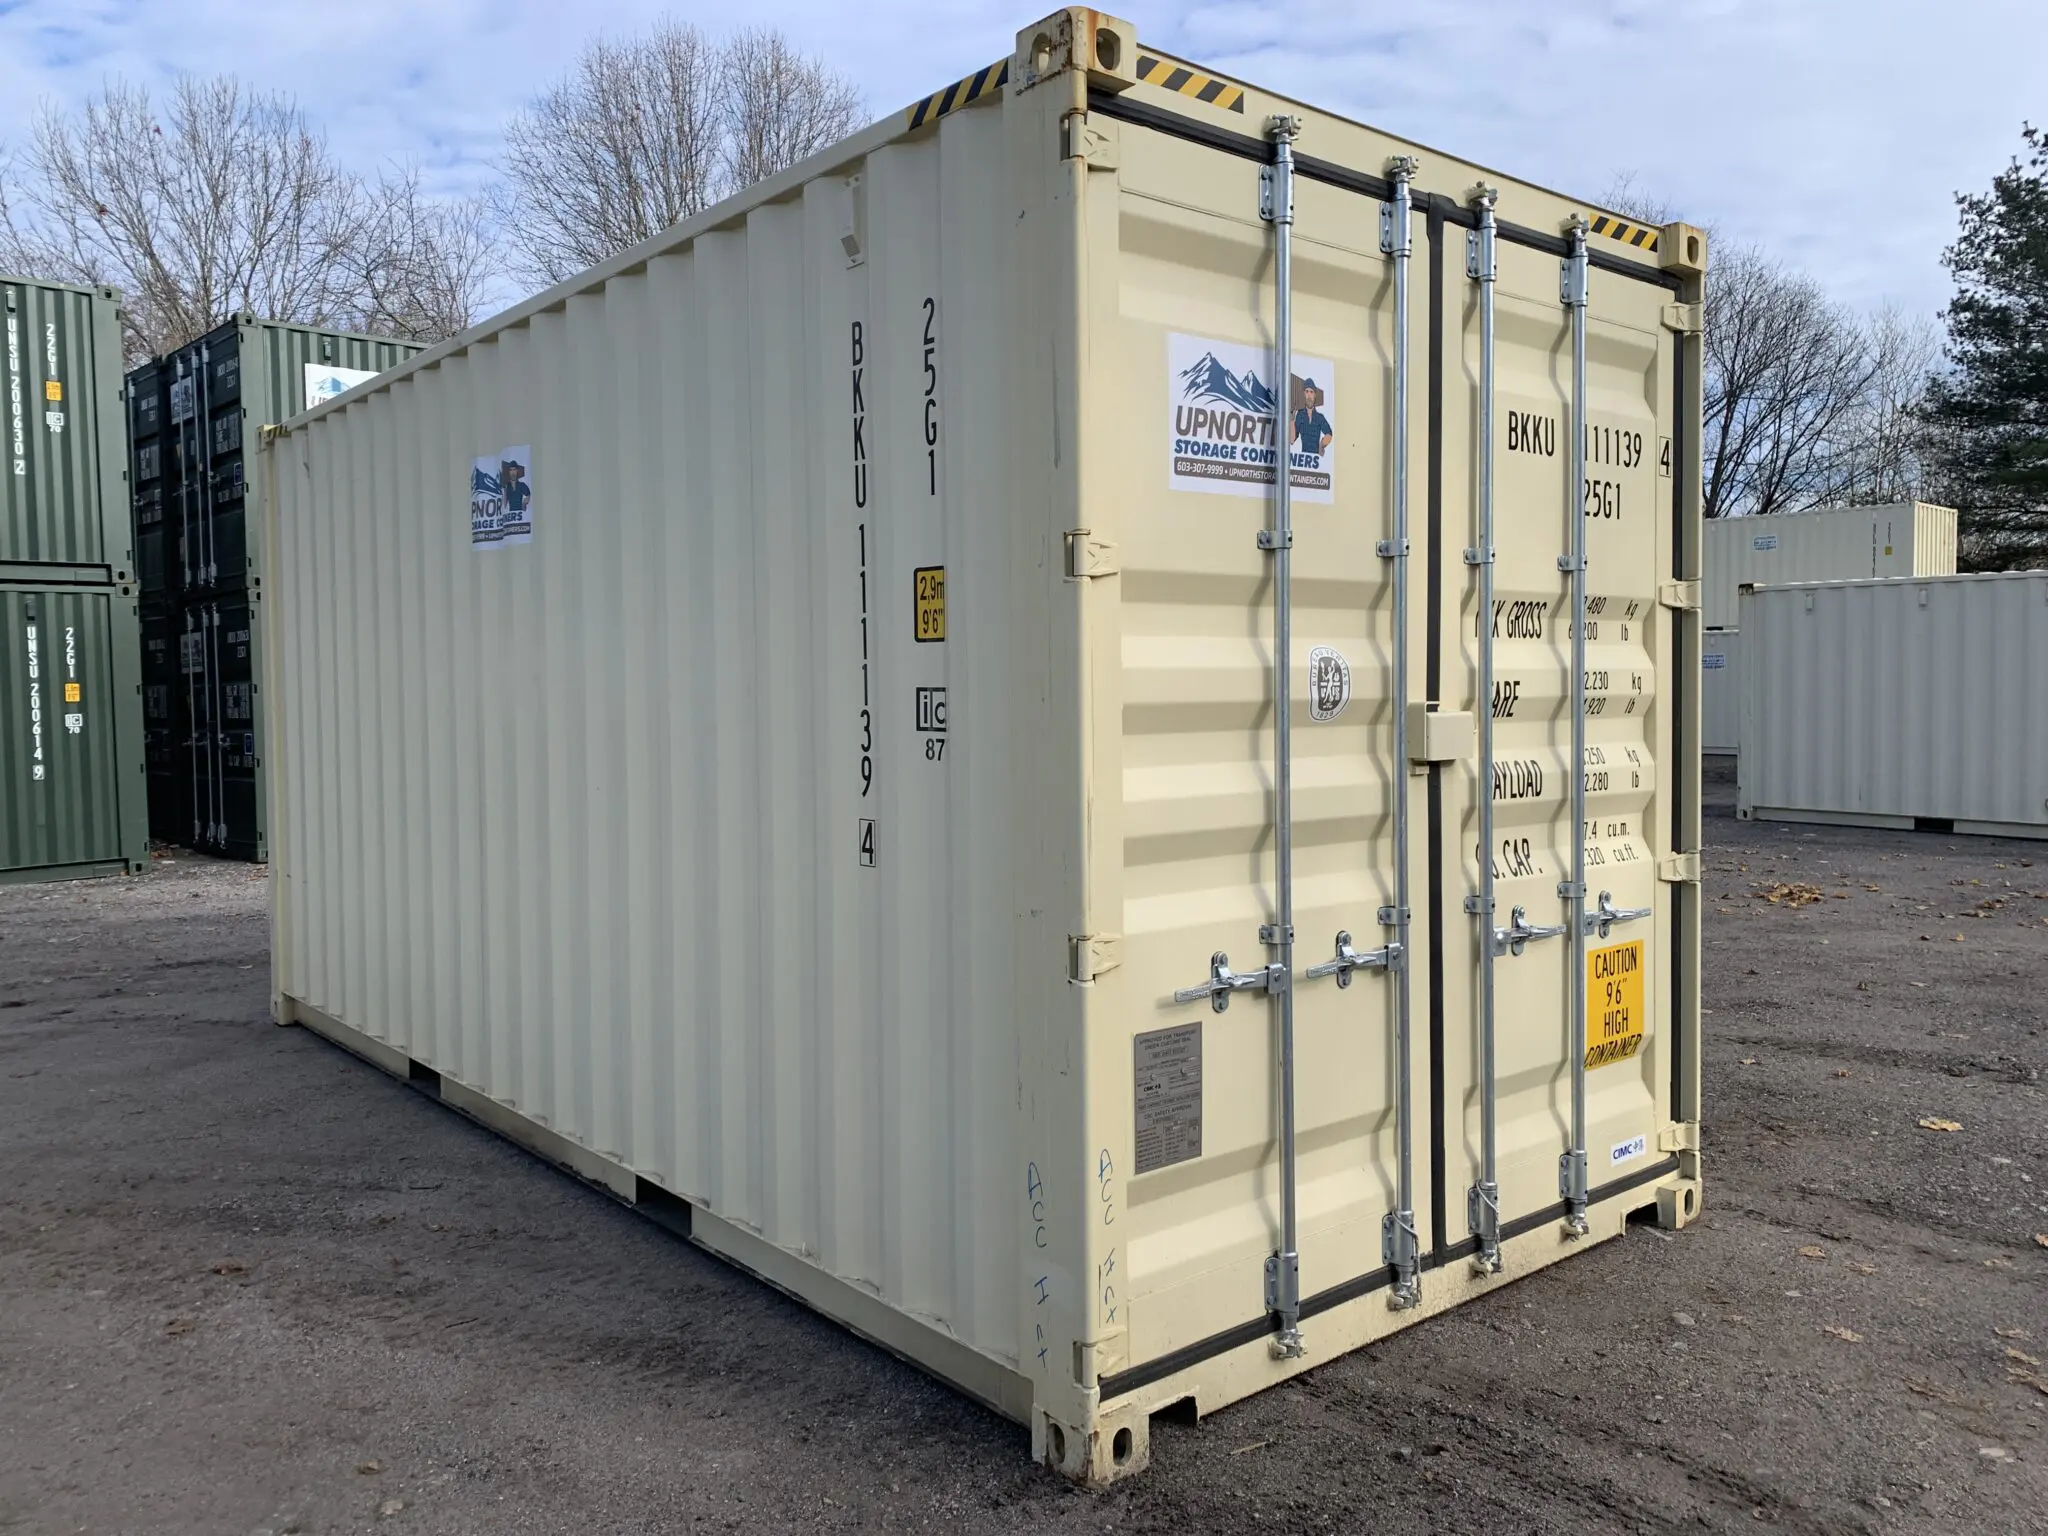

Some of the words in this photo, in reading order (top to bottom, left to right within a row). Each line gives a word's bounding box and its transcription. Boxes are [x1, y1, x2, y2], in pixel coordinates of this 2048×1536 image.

[7, 318, 19, 372] UNSU
[46, 323, 57, 376] 22G1
[851, 320, 867, 508] BKKU
[922, 297, 937, 496] 25G1
[11, 376, 24, 456] 200630
[1174, 438, 1237, 460] STORAGE
[1240, 446, 1320, 470] CONTNERS
[1507, 410, 1555, 457] BKKU
[1660, 439, 1671, 476] 4
[14, 460, 25, 474] 2
[1176, 461, 1224, 476] 603-307-9999
[1506, 600, 1548, 639] GROSS
[1624, 599, 1639, 621] kg
[26, 626, 39, 679] UNSU
[65, 627, 75, 678] 22G1
[858, 523, 873, 798] 111139
[1492, 681, 1521, 718] ARE
[1631, 671, 1641, 695] kg
[30, 682, 43, 760] 200614
[925, 738, 945, 762] 87
[1624, 746, 1640, 768] kg
[34, 766, 43, 779] 9
[1492, 759, 1543, 801] AYLOAD
[861, 821, 875, 865] 4
[1607, 822, 1630, 838] cu.m.
[1595, 945, 1637, 980] CAUTION
[1606, 977, 1628, 1007] 9'6"
[1604, 1007, 1629, 1038] HIGH
[1584, 1033, 1643, 1069] CONTAINER
[1612, 1143, 1633, 1160] CIMC
